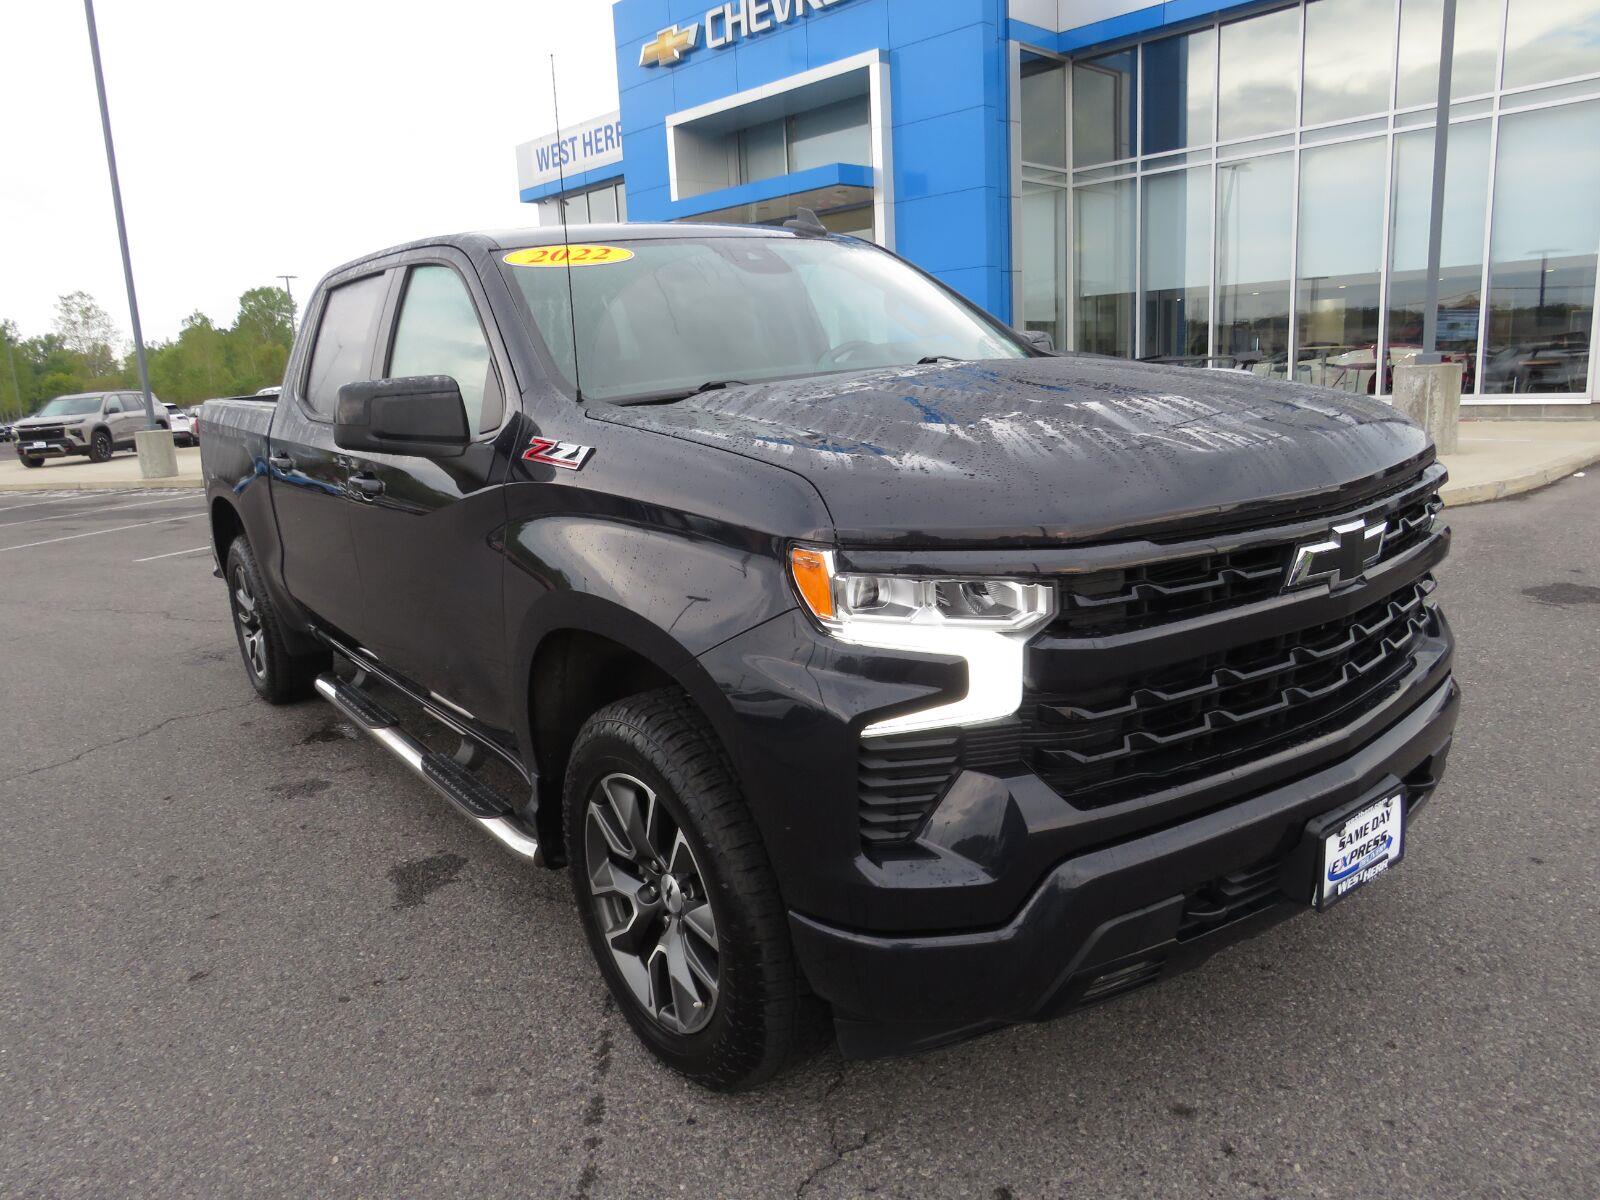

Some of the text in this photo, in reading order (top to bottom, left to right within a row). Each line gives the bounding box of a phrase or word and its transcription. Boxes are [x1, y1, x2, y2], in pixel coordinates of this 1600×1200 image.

[705, 0, 838, 49] CHEV
[536, 136, 577, 172] WEST
[527, 248, 611, 263] 2022
[521, 436, 593, 470] Z71
[1338, 808, 1393, 852] SAME DAY
[1331, 830, 1388, 875] EXPRESS
